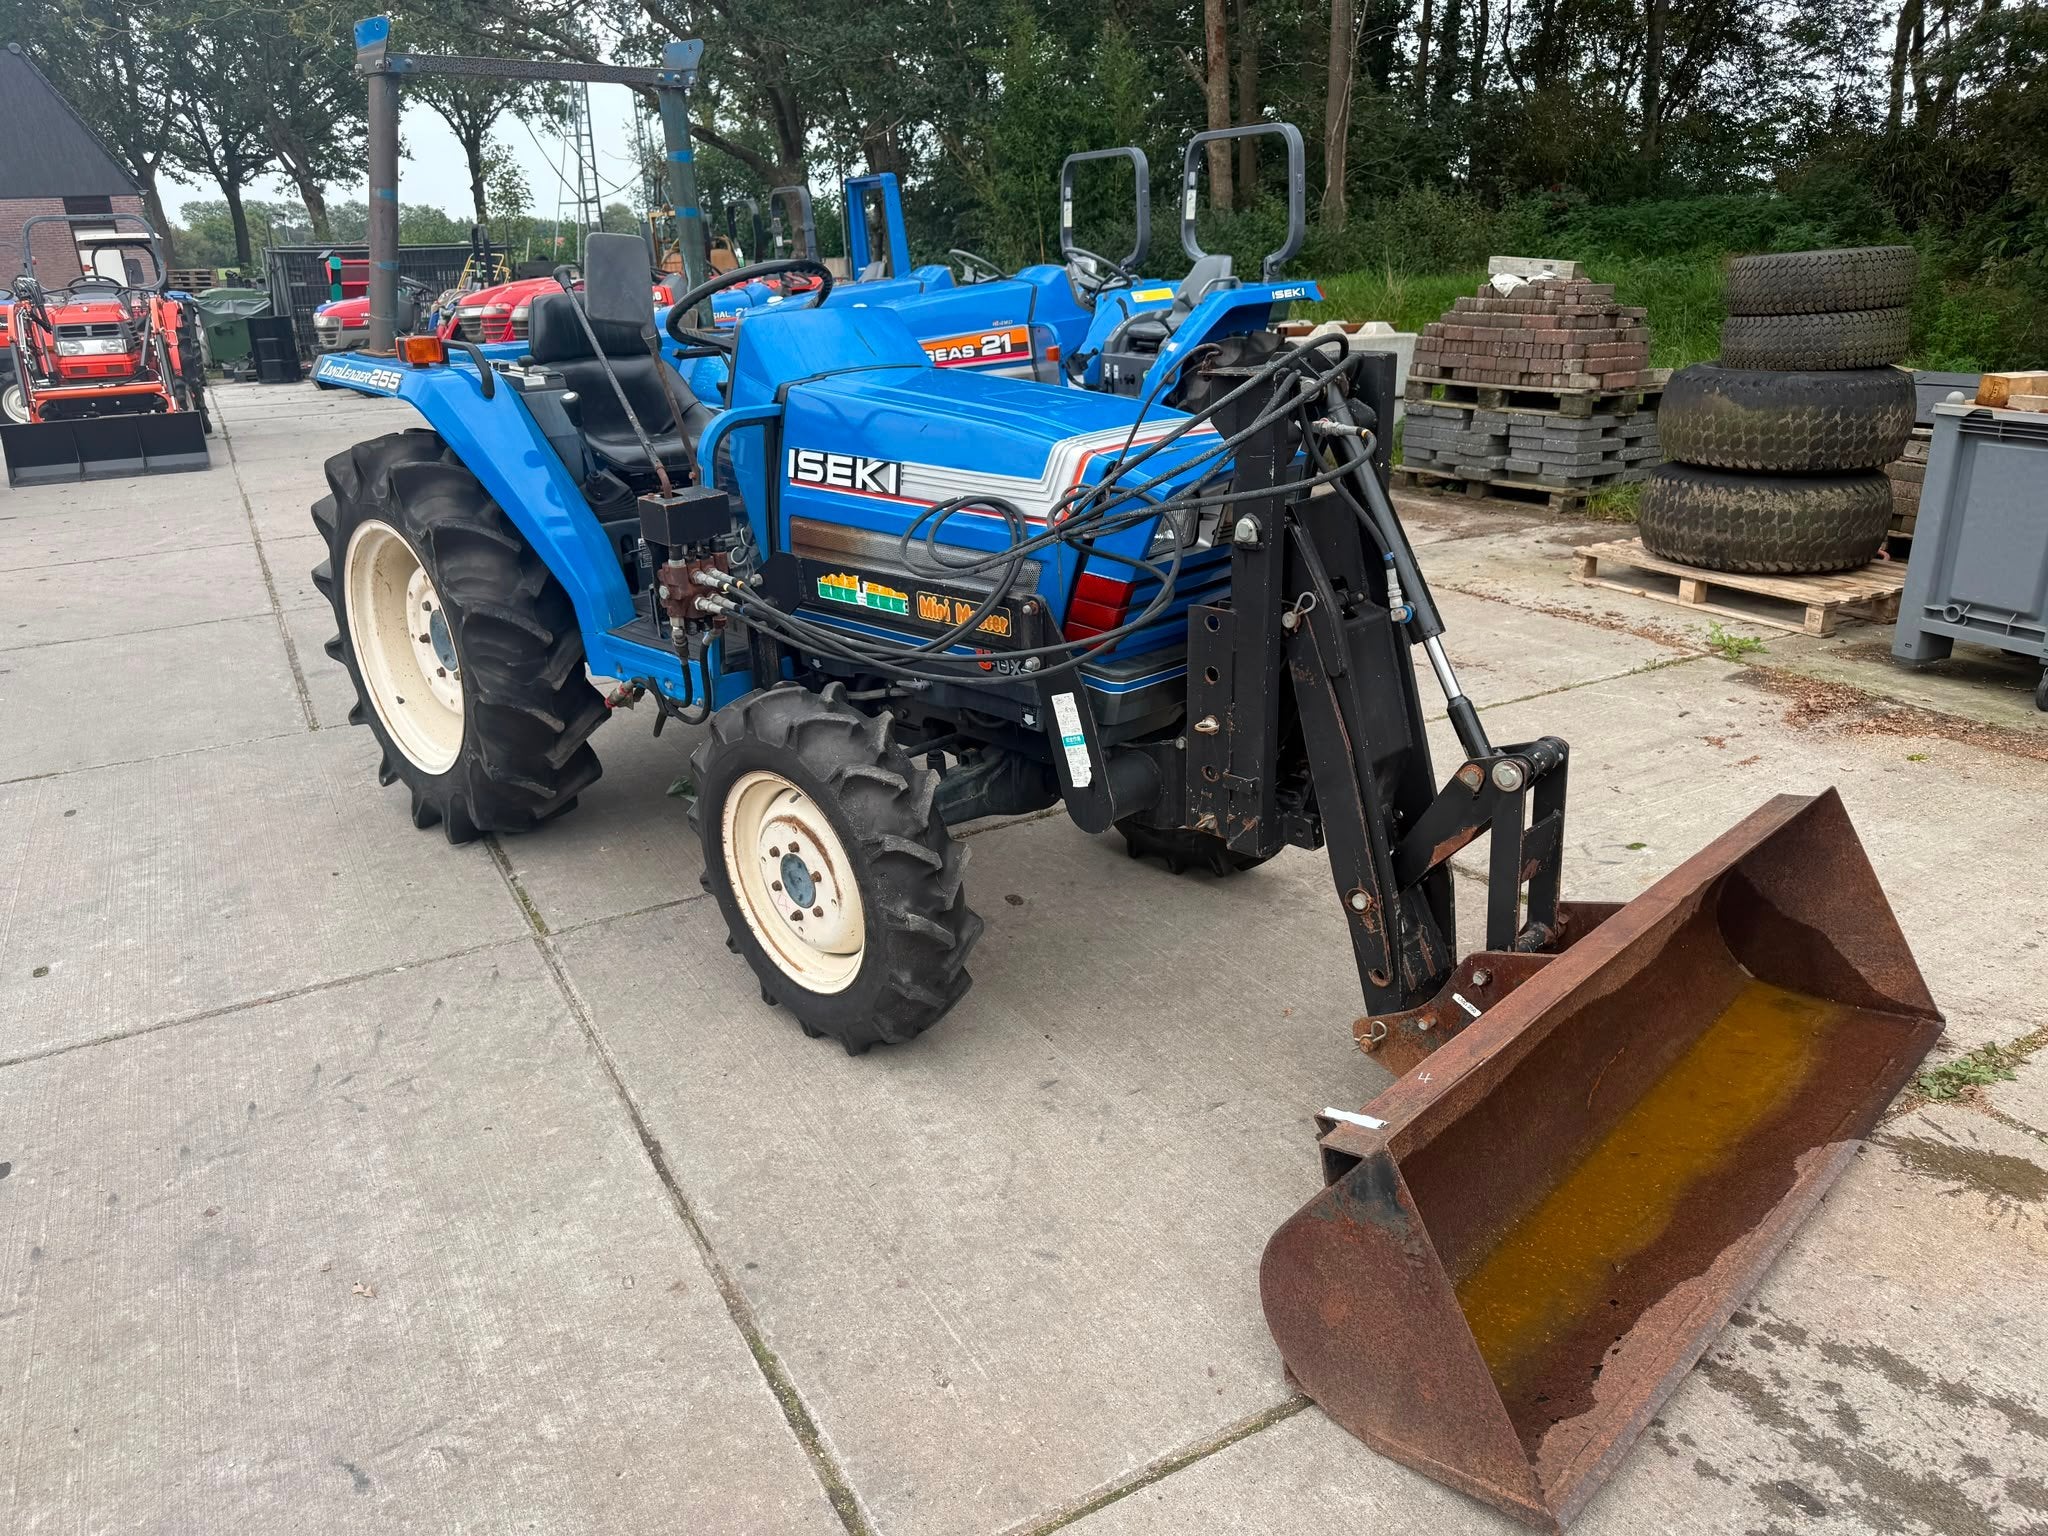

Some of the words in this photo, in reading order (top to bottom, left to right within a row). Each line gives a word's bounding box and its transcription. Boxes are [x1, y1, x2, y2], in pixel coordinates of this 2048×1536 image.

[1271, 287, 1305, 300] ISEKI
[980, 333, 1012, 356] 21
[788, 448, 897, 494] ISEKI
[919, 595, 951, 622] Mini
[955, 602, 1009, 633] Mter
[1417, 1072, 1434, 1084] 4
